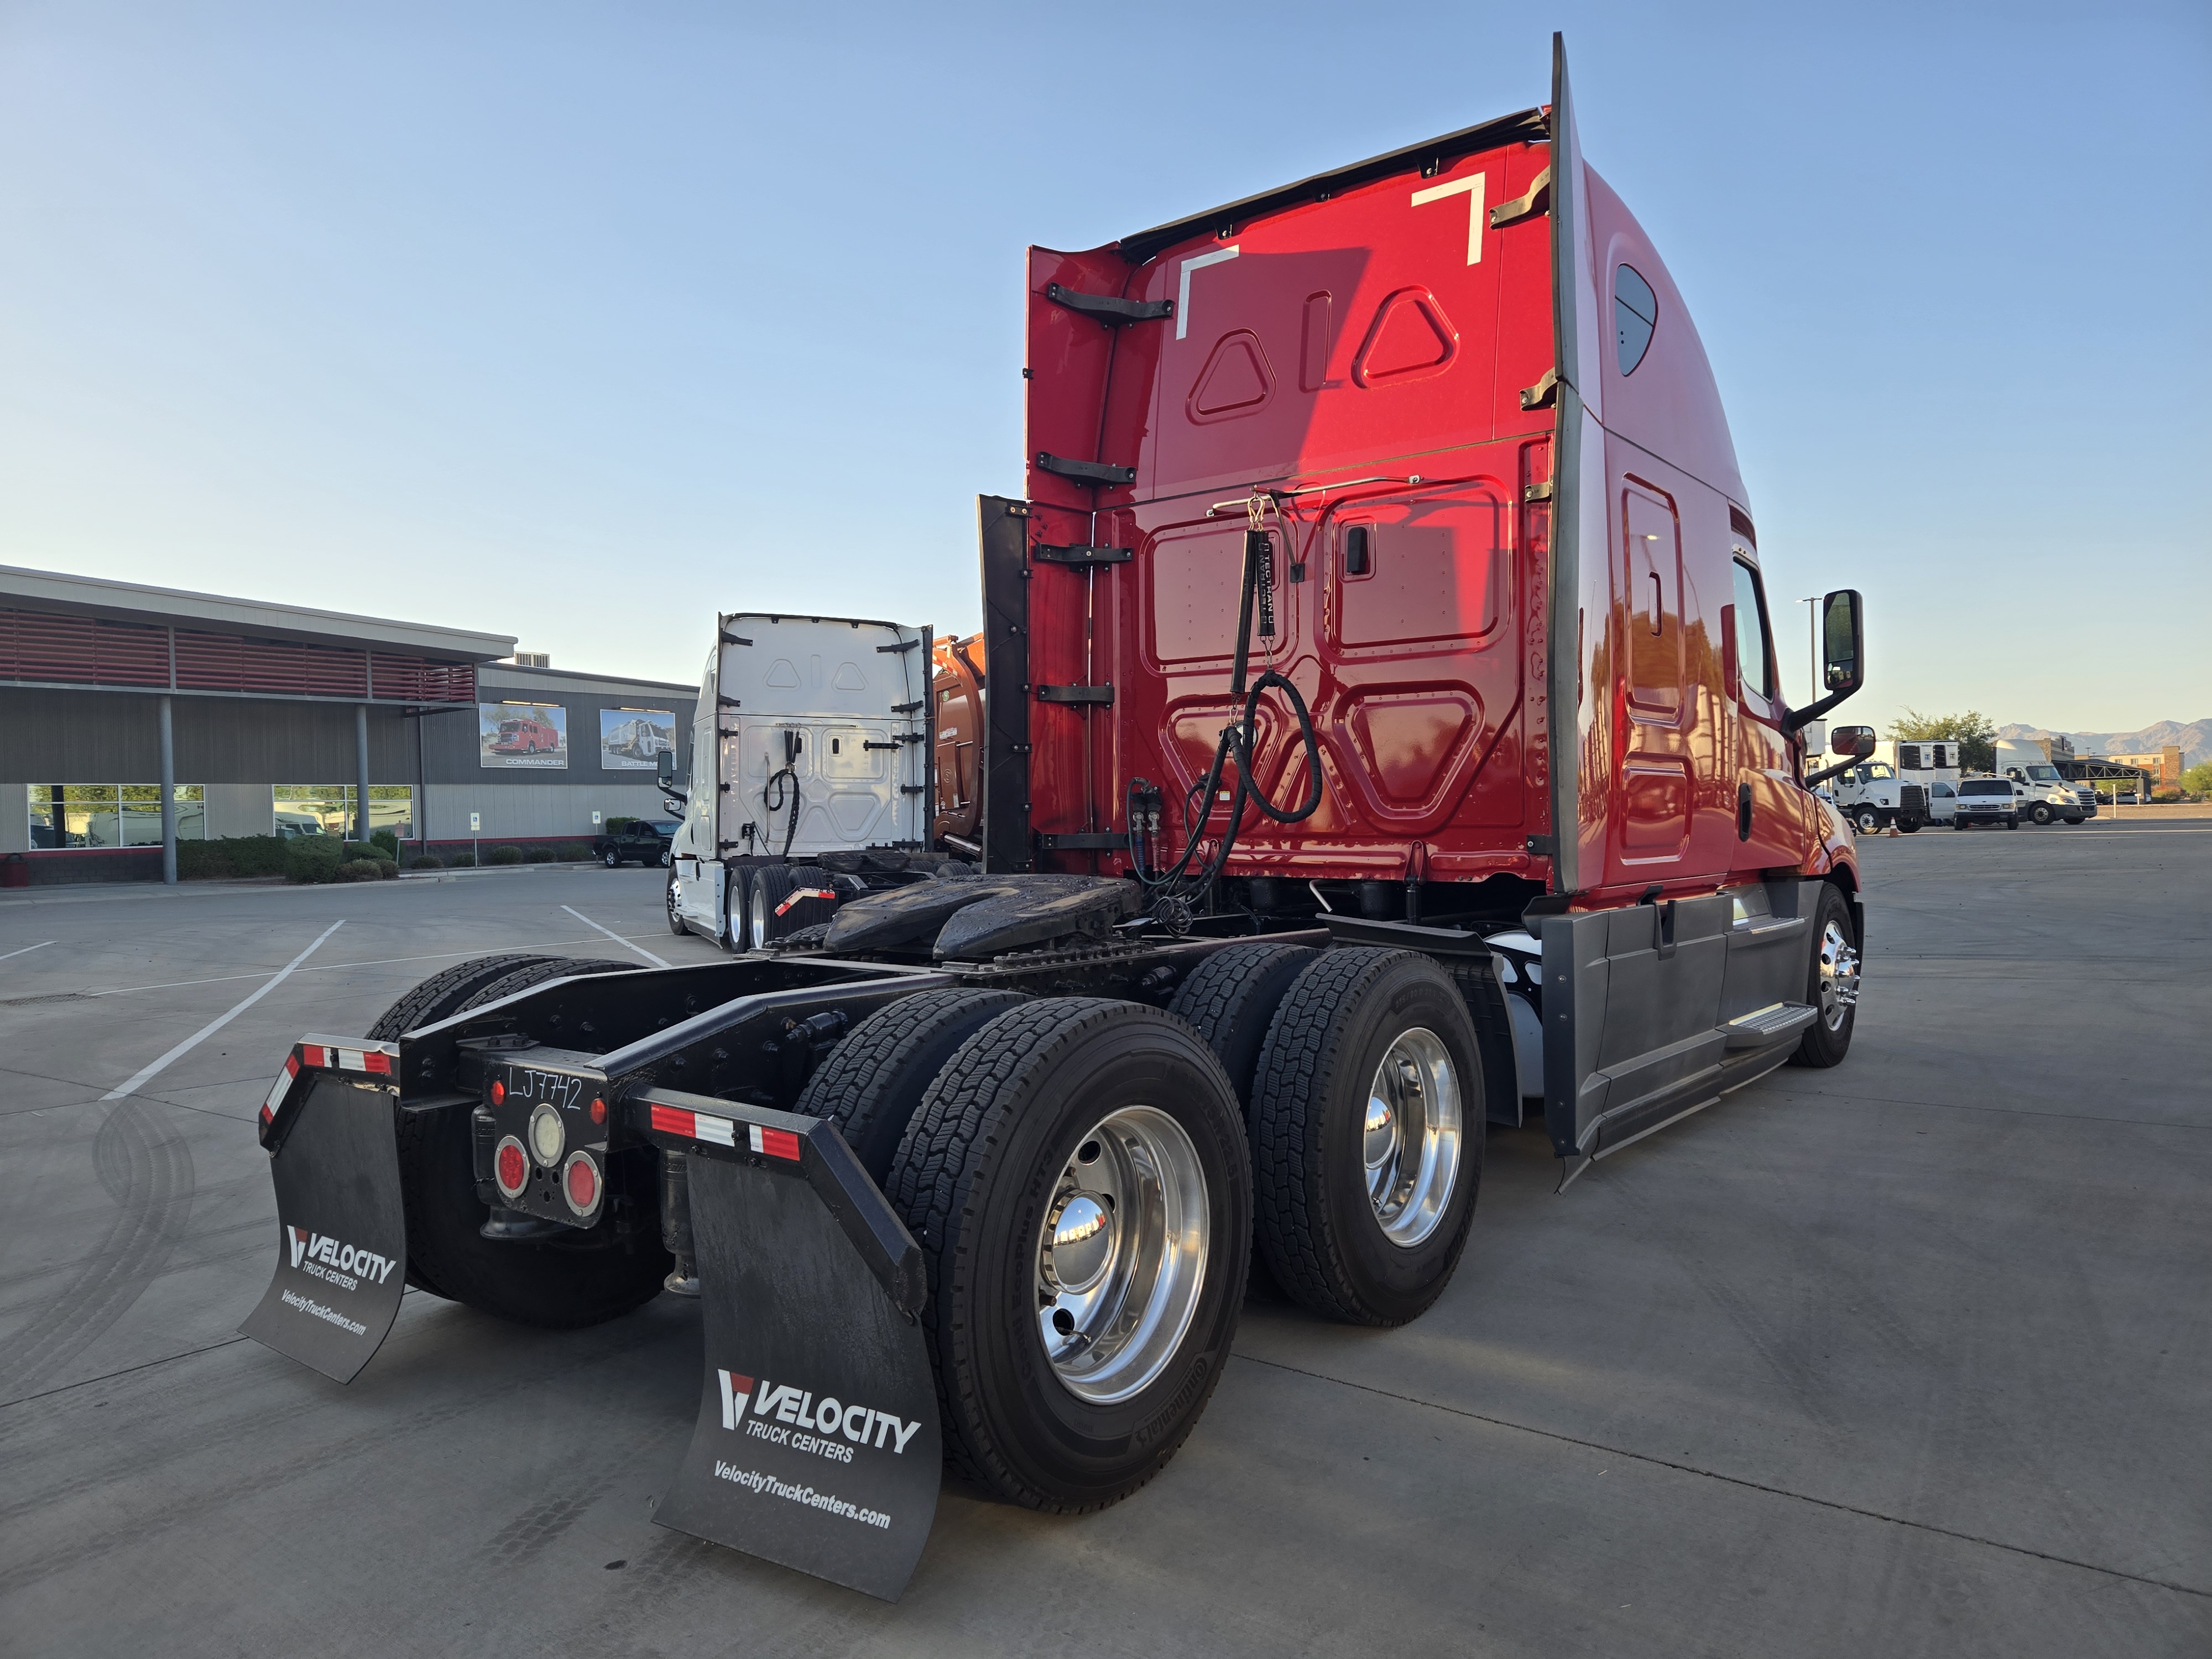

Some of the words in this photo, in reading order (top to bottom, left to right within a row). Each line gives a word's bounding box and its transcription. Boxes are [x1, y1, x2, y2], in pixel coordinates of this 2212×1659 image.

[1264, 555, 1273, 612] TECTRAN
[509, 1067, 581, 1110] LJ7742
[303, 1261, 326, 1279] TRUCK
[325, 1270, 358, 1291] CENTERS
[307, 1233, 397, 1284] VELOCITY
[281, 1289, 366, 1335] VelocityTruckCenters.com
[754, 1380, 921, 1454] VELOCITY
[1144, 1357, 1208, 1442] Continental
[746, 1420, 791, 1445] TRUCK
[791, 1432, 854, 1463] CENTERS
[714, 1460, 890, 1529] VelocityTruckCenters.com
